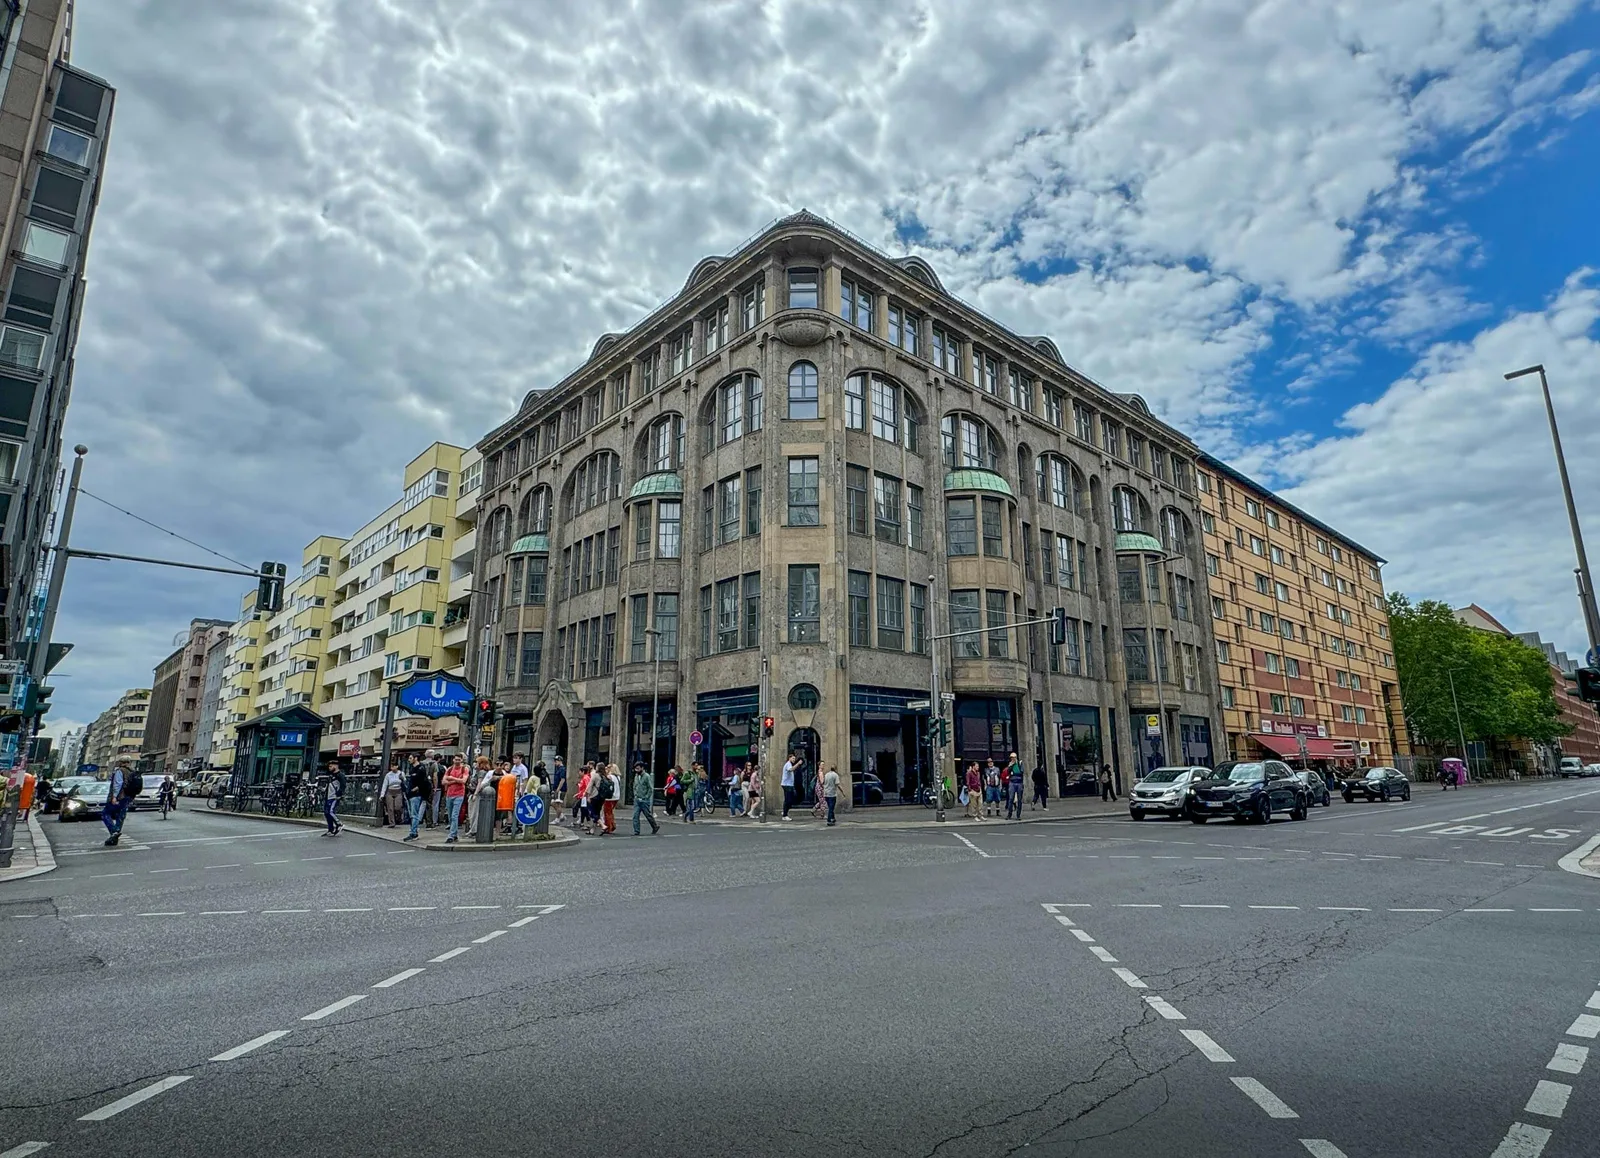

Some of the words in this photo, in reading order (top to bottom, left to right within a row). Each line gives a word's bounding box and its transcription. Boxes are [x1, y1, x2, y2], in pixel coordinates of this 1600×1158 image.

[431, 680, 447, 698] U
[414, 698, 459, 708] Kochstraße
[1427, 825, 1582, 838] BUS
